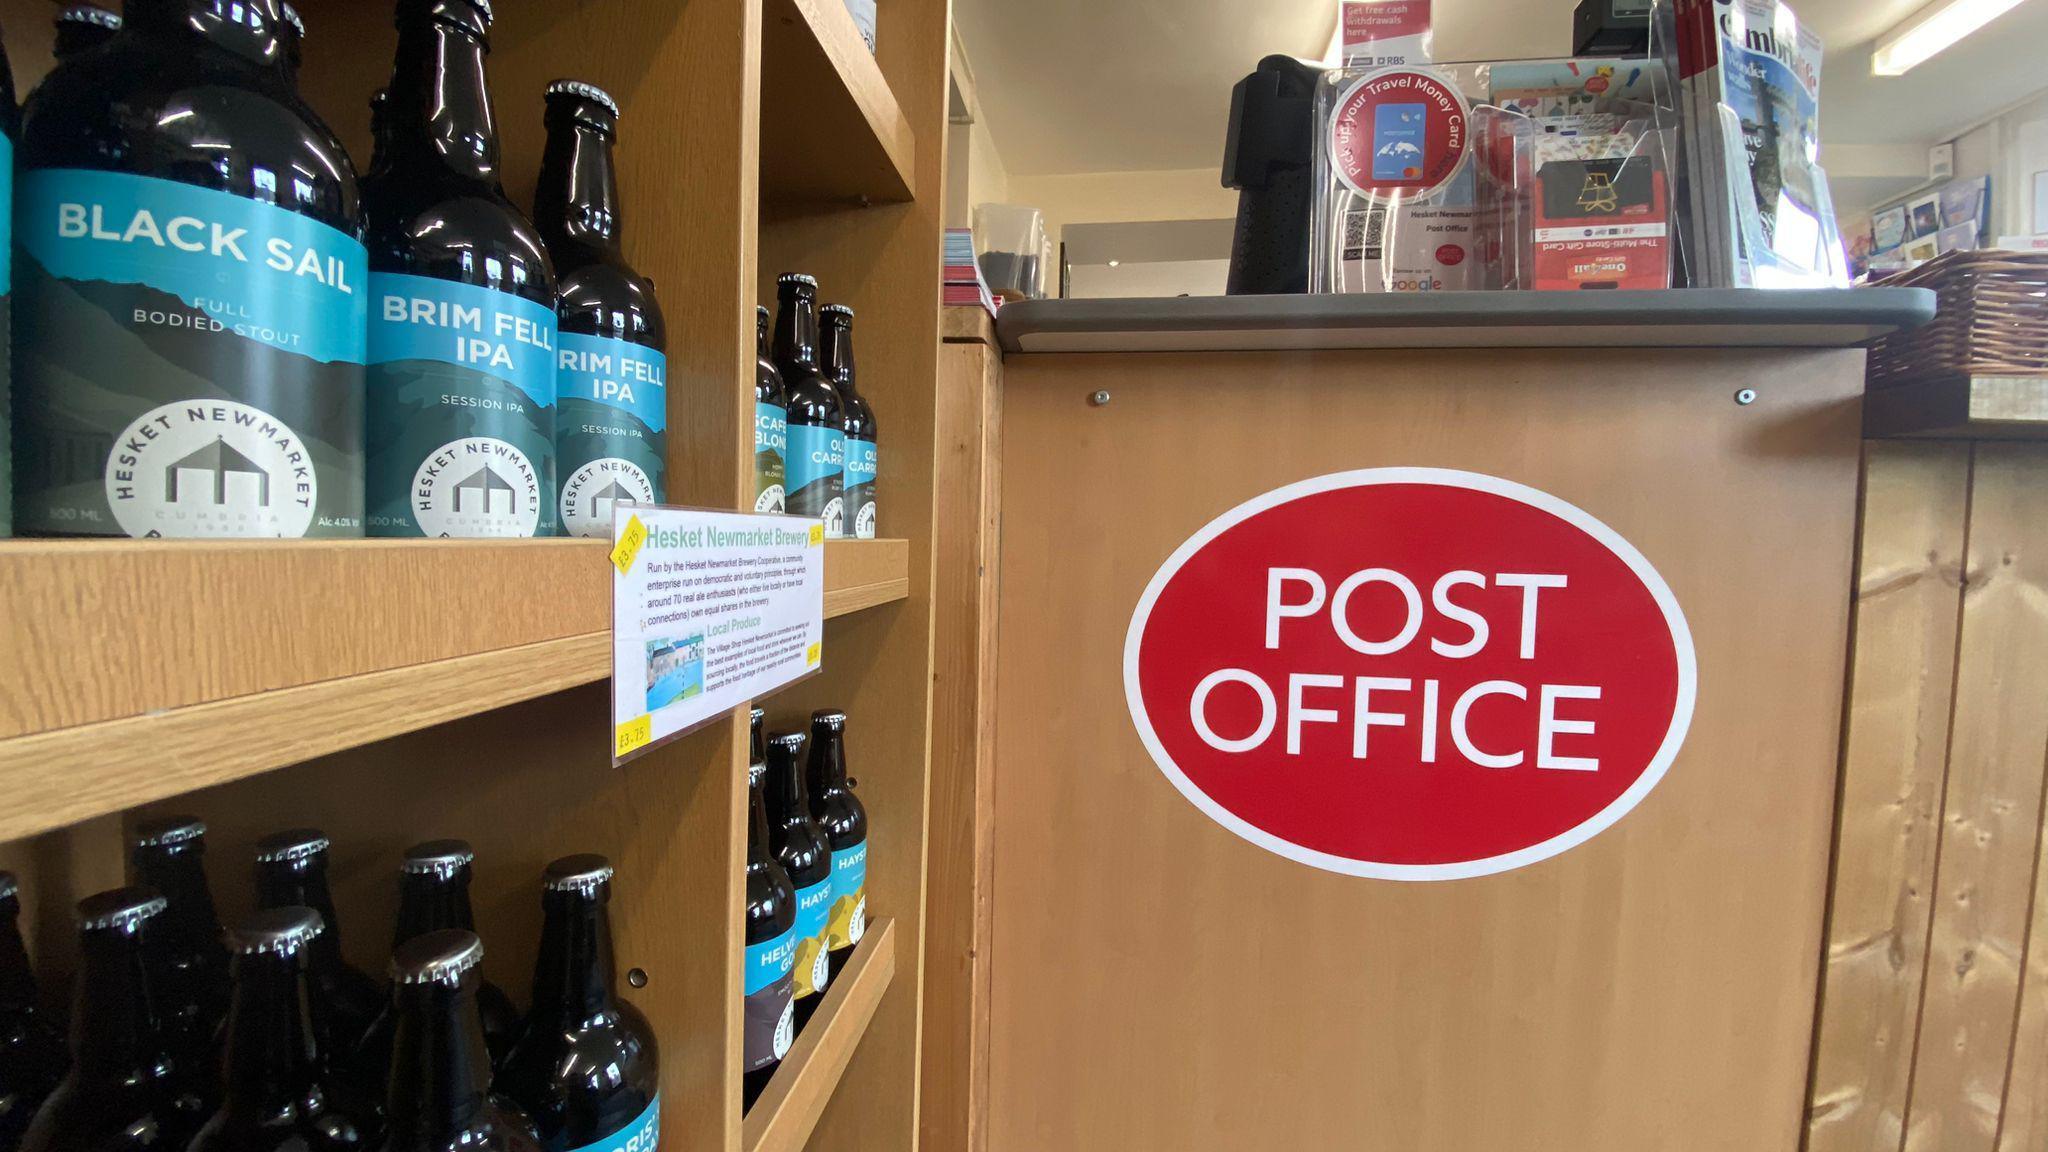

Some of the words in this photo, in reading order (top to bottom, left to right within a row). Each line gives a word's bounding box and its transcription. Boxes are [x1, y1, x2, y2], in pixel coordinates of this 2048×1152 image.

[1347, 6, 1363, 16] Get
[1365, 6, 1384, 15] free
[1387, 4, 1408, 14] cash
[1387, 55, 1405, 65] RBS
[1366, 76, 1411, 96] Travel
[1414, 77, 1454, 114] Money
[1345, 93, 1366, 126] your
[1339, 126, 1352, 145] up
[1447, 114, 1461, 149] Card
[1339, 146, 1361, 177] Pick
[1426, 224, 1443, 233] Post
[1445, 224, 1469, 233] Office
[58, 203, 248, 262] BLACK
[266, 238, 352, 294] SAIL
[1542, 242, 1565, 251] Card
[1565, 242, 1583, 250] Gift
[1586, 239, 1637, 249] Multi-Store
[1640, 239, 1658, 247] The
[193, 297, 251, 319] FULL
[134, 309, 225, 333] BODIED
[233, 322, 301, 347] STOUT
[383, 295, 482, 332] BRIM
[494, 311, 552, 352] FELL
[457, 336, 514, 370] IPA
[558, 349, 611, 375] RIM
[621, 358, 663, 387] FELL
[593, 379, 635, 404] IPA
[441, 394, 501, 411] SESSION
[506, 402, 525, 414] IPA
[582, 425, 627, 437] SESSION
[629, 428, 643, 439] IPA
[755, 430, 787, 450] BLON
[830, 439, 845, 452] OL
[117, 414, 172, 500] HESKET
[187, 406, 310, 508] NEWMARKET
[849, 461, 877, 475] CARR
[419, 449, 456, 511] HESKET
[465, 443, 537, 515] NEWMARKET
[566, 468, 594, 518] HESKET
[600, 462, 652, 503] NEWMARK
[80, 508, 104, 522] ML
[154, 510, 279, 523] CUMBRIA
[392, 517, 410, 528] ML
[646, 525, 702, 548] Hesket
[707, 526, 774, 548] Newmarket
[775, 529, 808, 549] Brewery
[619, 529, 639, 568] £3.75
[647, 562, 662, 573] Run
[664, 561, 672, 574] by
[674, 561, 684, 571] the
[685, 560, 707, 571] Hesket
[708, 558, 737, 569] Newmarket
[738, 557, 756, 567] Brewery
[647, 580, 681, 592] enterprise
[683, 579, 694, 587] run
[694, 577, 702, 585] on
[703, 574, 732, 585] democratic
[734, 572, 743, 582] and
[744, 570, 763, 580] voluntary
[647, 596, 671, 609] around
[673, 594, 682, 604] 70
[683, 593, 695, 603] real
[696, 592, 705, 601] ale
[706, 588, 736, 600] enthusiasts
[737, 586, 748, 598] (who
[647, 609, 689, 626] connections)
[691, 608, 703, 618] own
[704, 604, 720, 616] equal
[721, 602, 738, 613] shares
[1265, 567, 1568, 660] POST
[707, 619, 730, 637] Local
[732, 616, 761, 632] Produce
[707, 646, 715, 655] The
[716, 644, 731, 653] Village
[731, 640, 741, 649] Shop
[714, 656, 724, 666] best
[724, 651, 743, 662] examples
[705, 680, 725, 692] supports
[1190, 668, 1602, 772] OFFICE
[620, 726, 645, 748] £3.75
[761, 934, 796, 966] HELV
